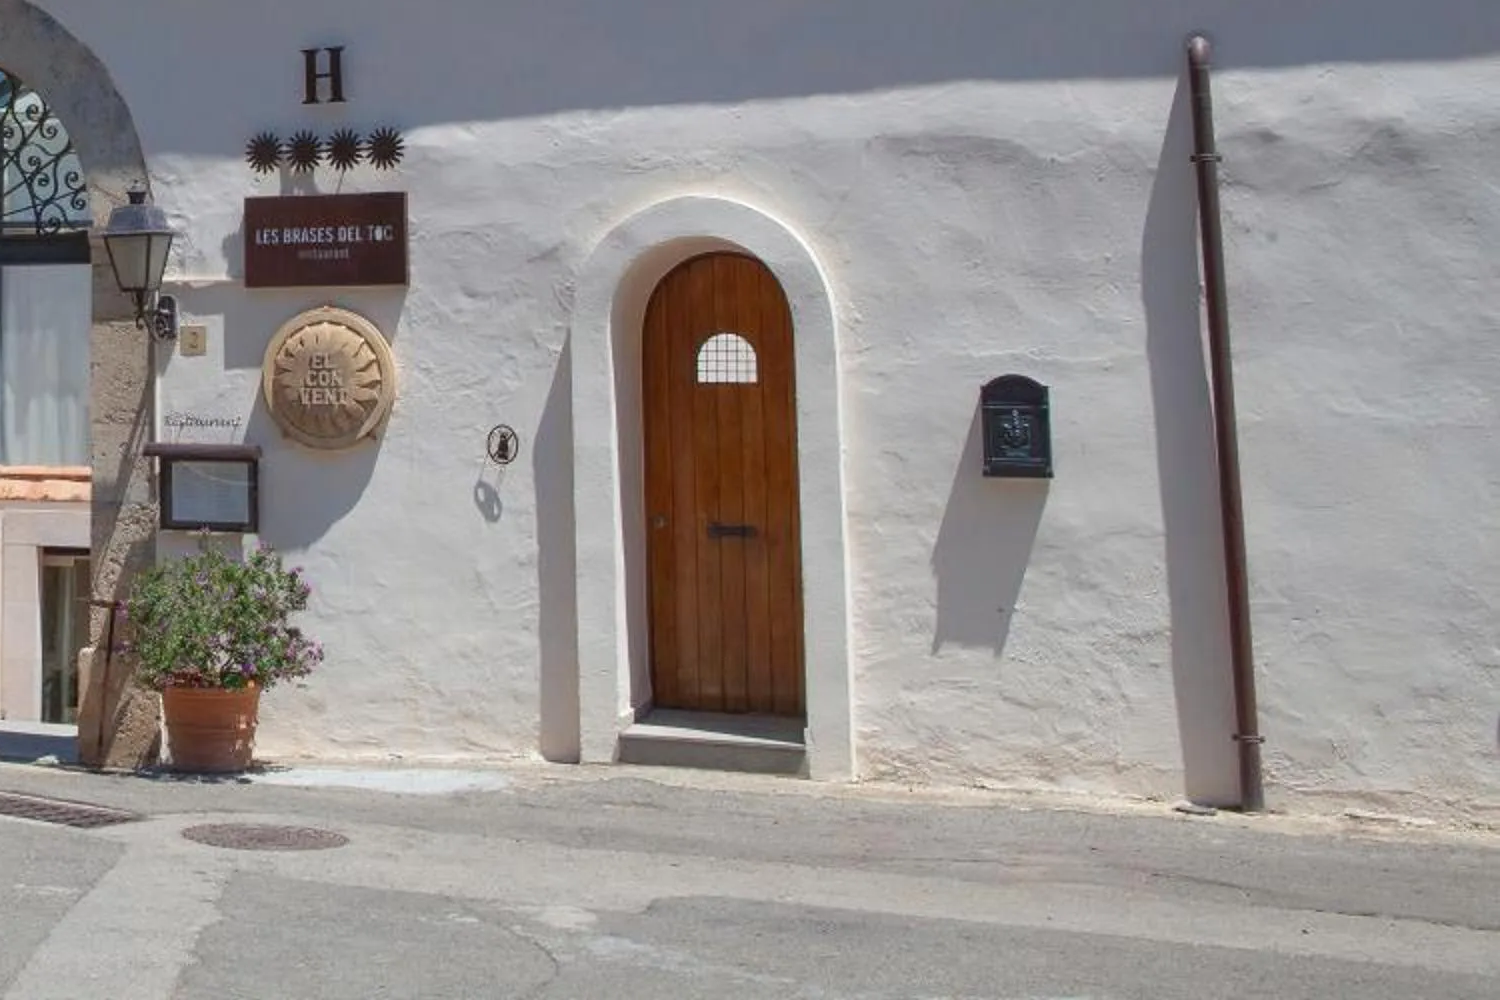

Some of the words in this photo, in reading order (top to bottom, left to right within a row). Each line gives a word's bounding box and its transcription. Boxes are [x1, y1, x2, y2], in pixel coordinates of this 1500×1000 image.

[300, 46, 347, 104] H
[255, 228, 279, 245] LES
[283, 226, 333, 244] BRASES
[337, 225, 363, 242] DEL
[311, 351, 338, 369] EL
[307, 370, 343, 386] CON
[301, 388, 349, 405] VENT
